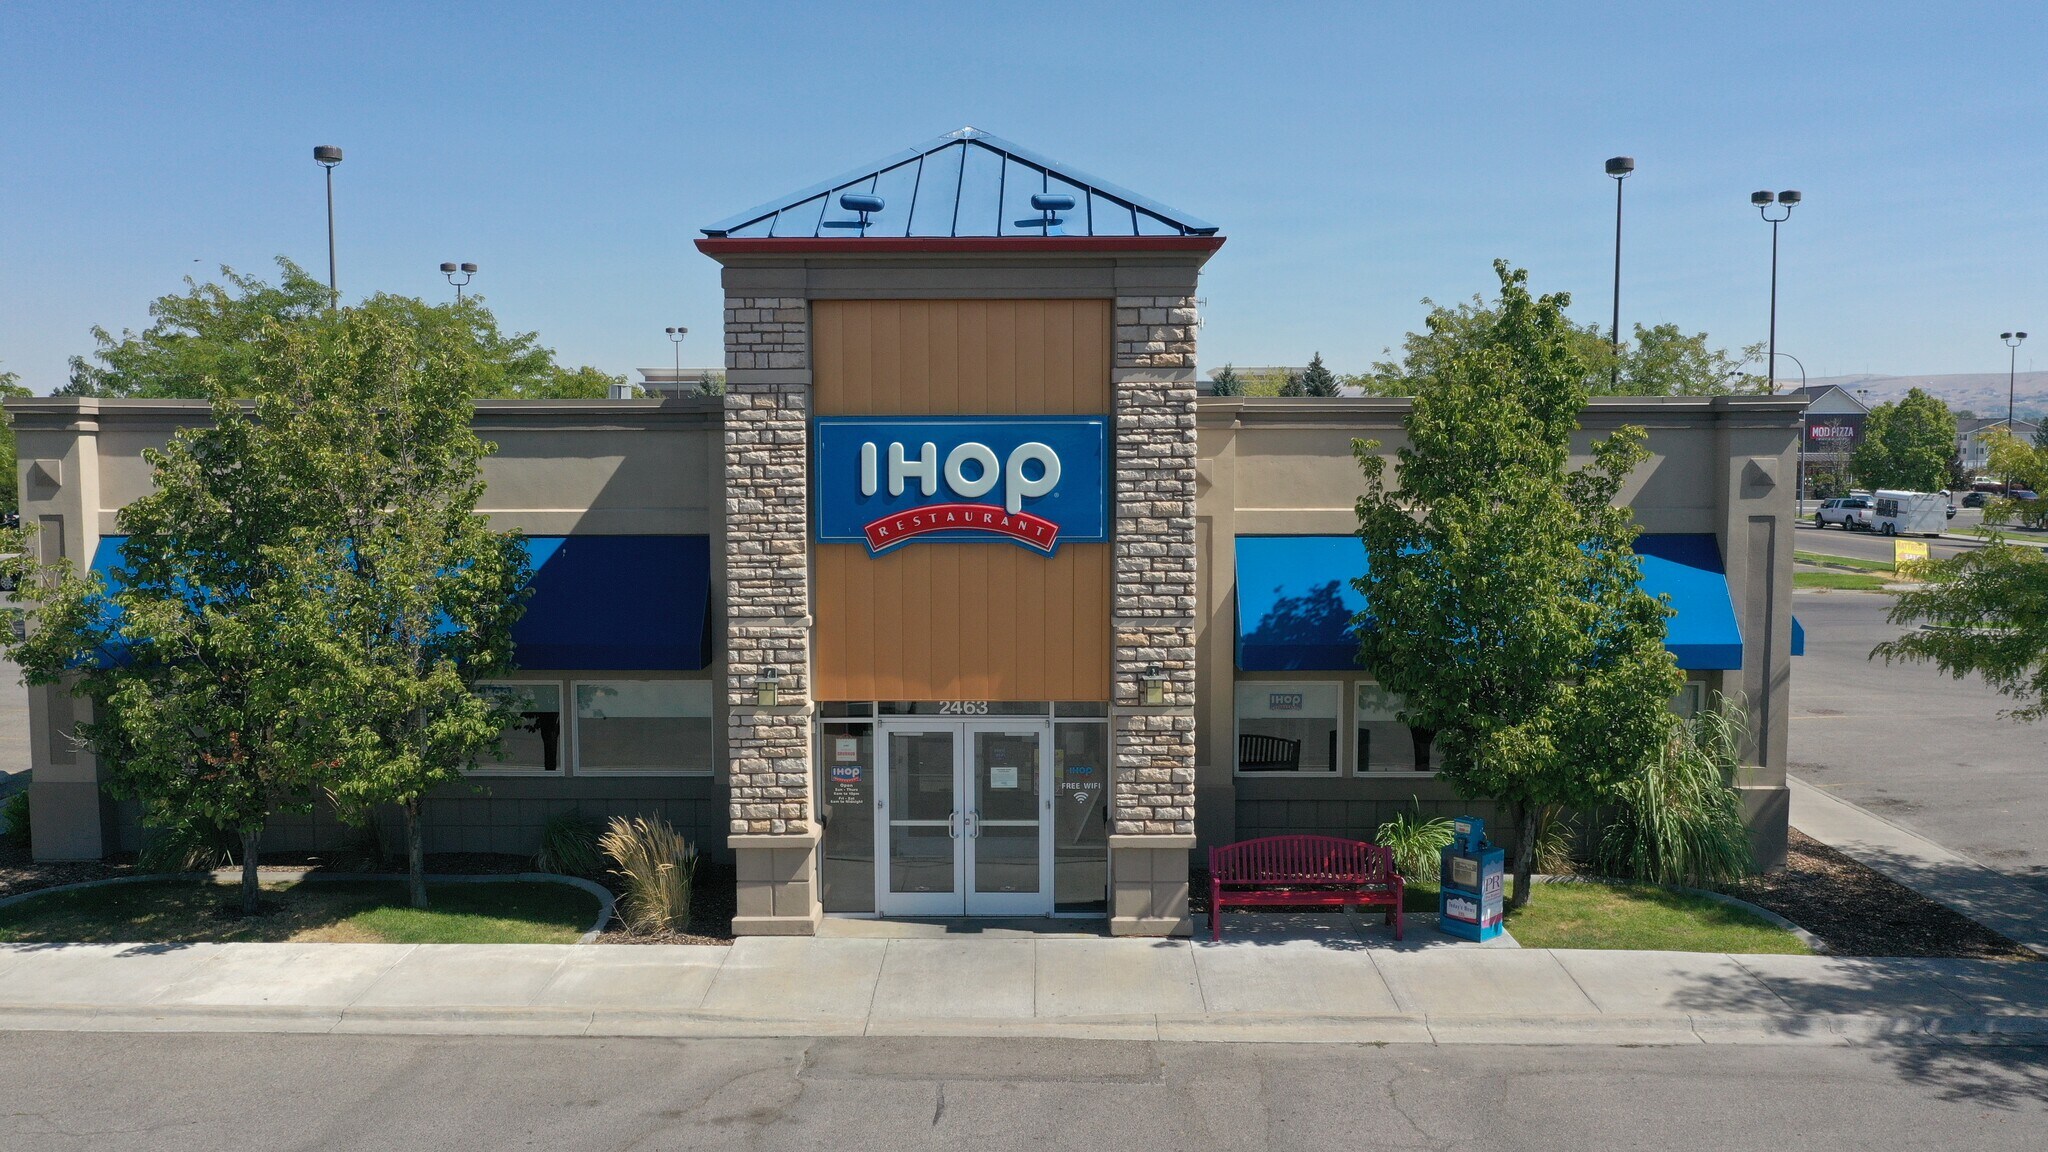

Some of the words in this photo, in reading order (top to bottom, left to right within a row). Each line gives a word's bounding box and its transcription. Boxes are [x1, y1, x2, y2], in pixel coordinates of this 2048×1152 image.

[1813, 427, 1830, 436] MOD
[1831, 427, 1853, 436] PIZZA
[860, 441, 1062, 515] IHOP
[878, 511, 1046, 538] RESTAURANT
[1271, 695, 1301, 706] IHOP
[939, 701, 989, 715] 2463
[833, 768, 859, 777] IHOP
[1061, 782, 1080, 790] FREE
[1083, 782, 1101, 790] WIFI
[1486, 875, 1500, 891] PR
